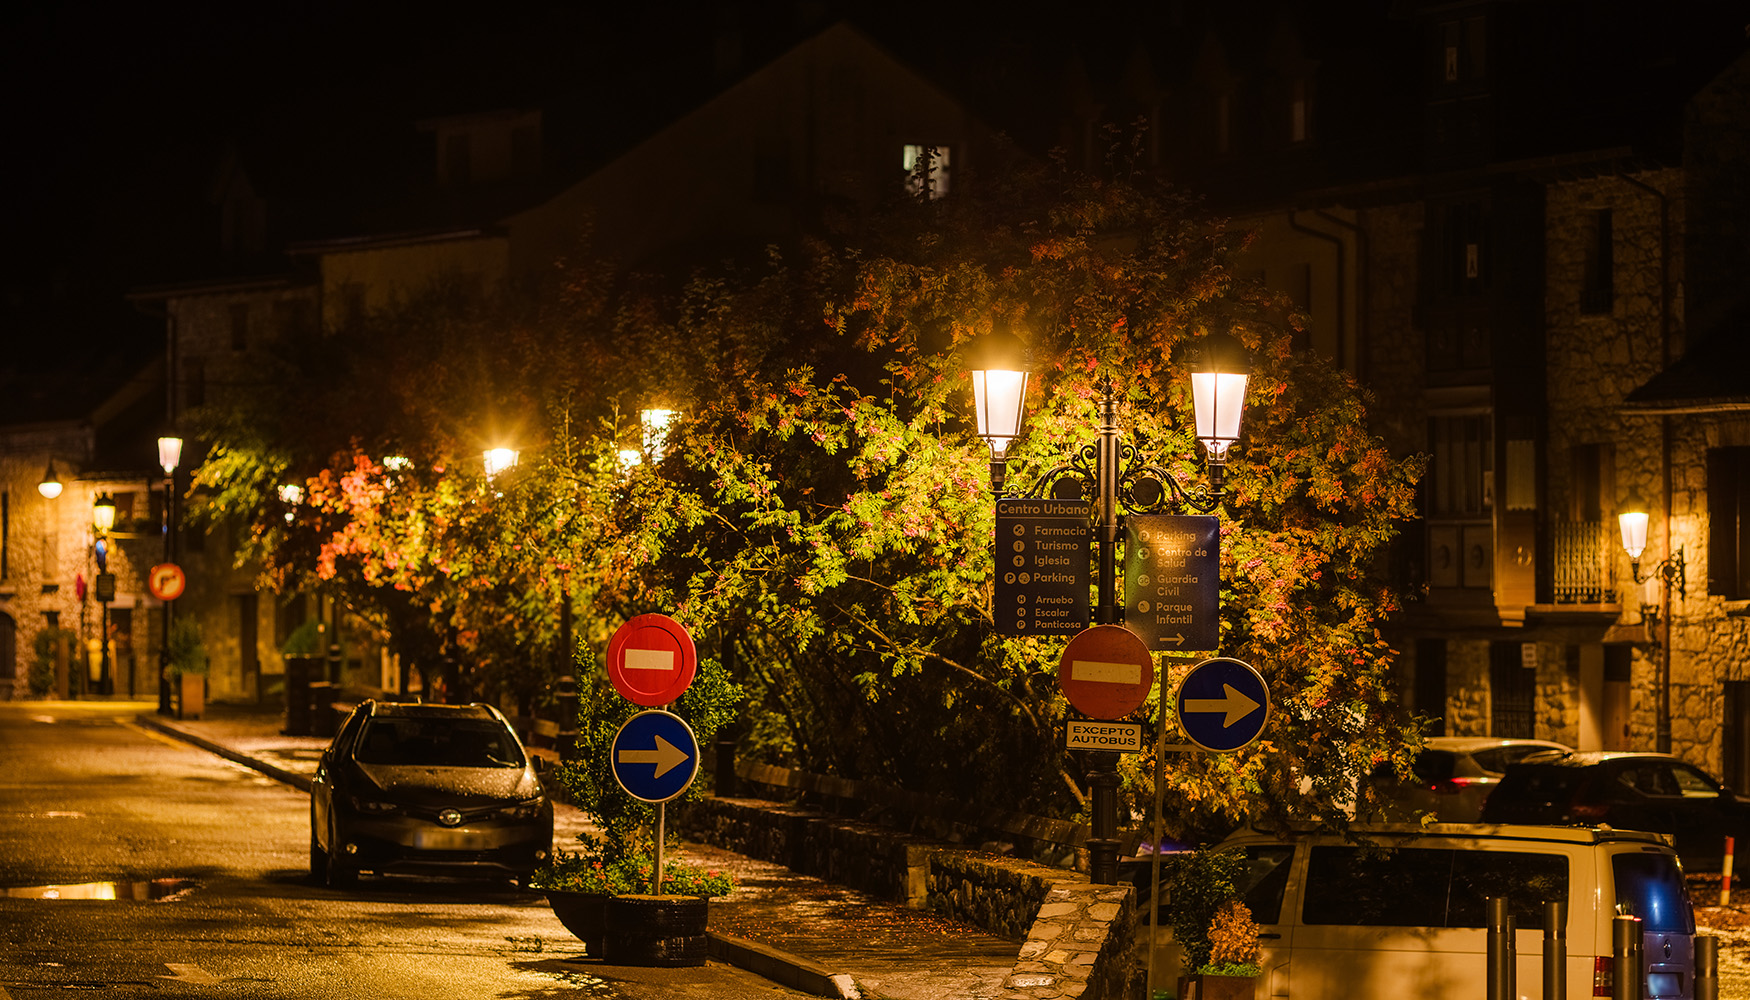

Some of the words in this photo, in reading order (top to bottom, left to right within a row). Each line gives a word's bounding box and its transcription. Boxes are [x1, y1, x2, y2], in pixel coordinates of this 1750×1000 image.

[999, 503, 1040, 514] Centro
[1044, 503, 1089, 515] Urbano
[1034, 525, 1087, 536] Farmacia
[1156, 531, 1196, 542] Parking
[1035, 540, 1079, 550] Turismo
[1157, 547, 1192, 557] Centro
[1194, 547, 1208, 557] de
[1034, 555, 1070, 567] Iglesia
[1157, 558, 1186, 568] Salud
[1033, 572, 1076, 585] Parking
[1157, 574, 1198, 584] Guardia
[1157, 587, 1180, 596] Civil
[1035, 595, 1074, 604] Arruebo
[1035, 608, 1070, 617] Escalar
[1156, 602, 1193, 613] Parque
[1156, 614, 1193, 624] Infantil
[1035, 620, 1081, 629] Panticosa
[1073, 726, 1136, 736] EXCEPTO
[1072, 735, 1136, 746] AUTOBUS
